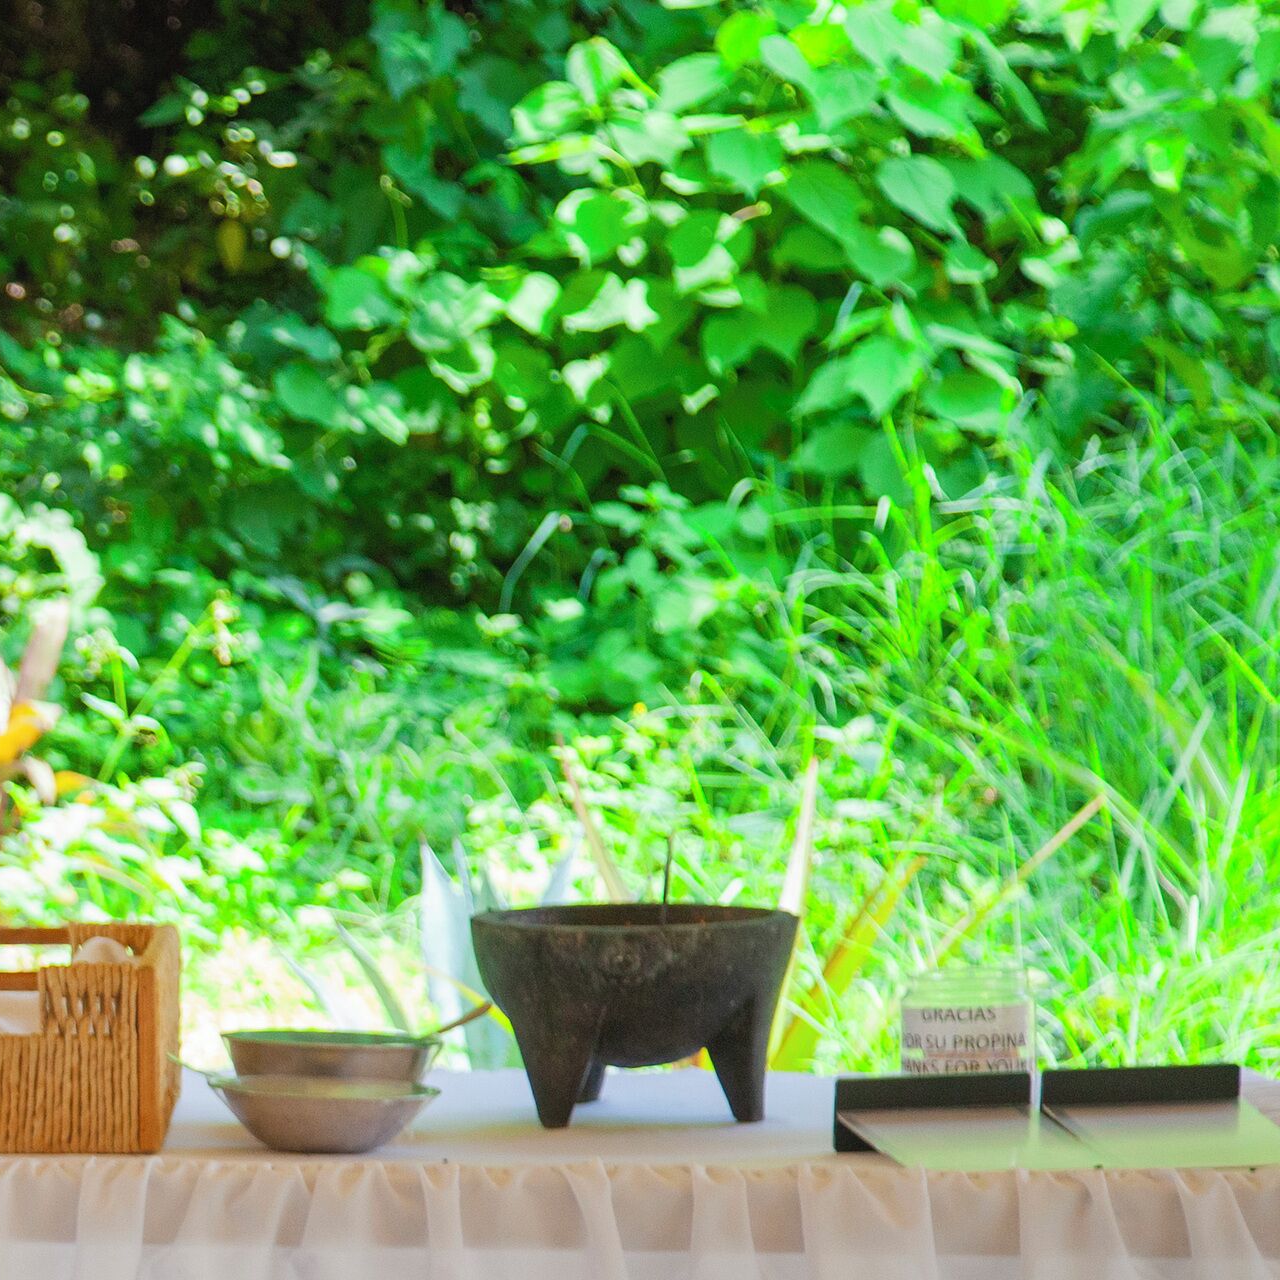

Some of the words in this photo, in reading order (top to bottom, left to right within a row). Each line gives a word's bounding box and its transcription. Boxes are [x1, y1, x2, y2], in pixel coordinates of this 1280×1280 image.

[921, 1006, 997, 1022] GRACIAS
[926, 1033, 947, 1049] SU
[952, 1032, 1027, 1051] PROPINA
[902, 1057, 940, 1073] ANKS
